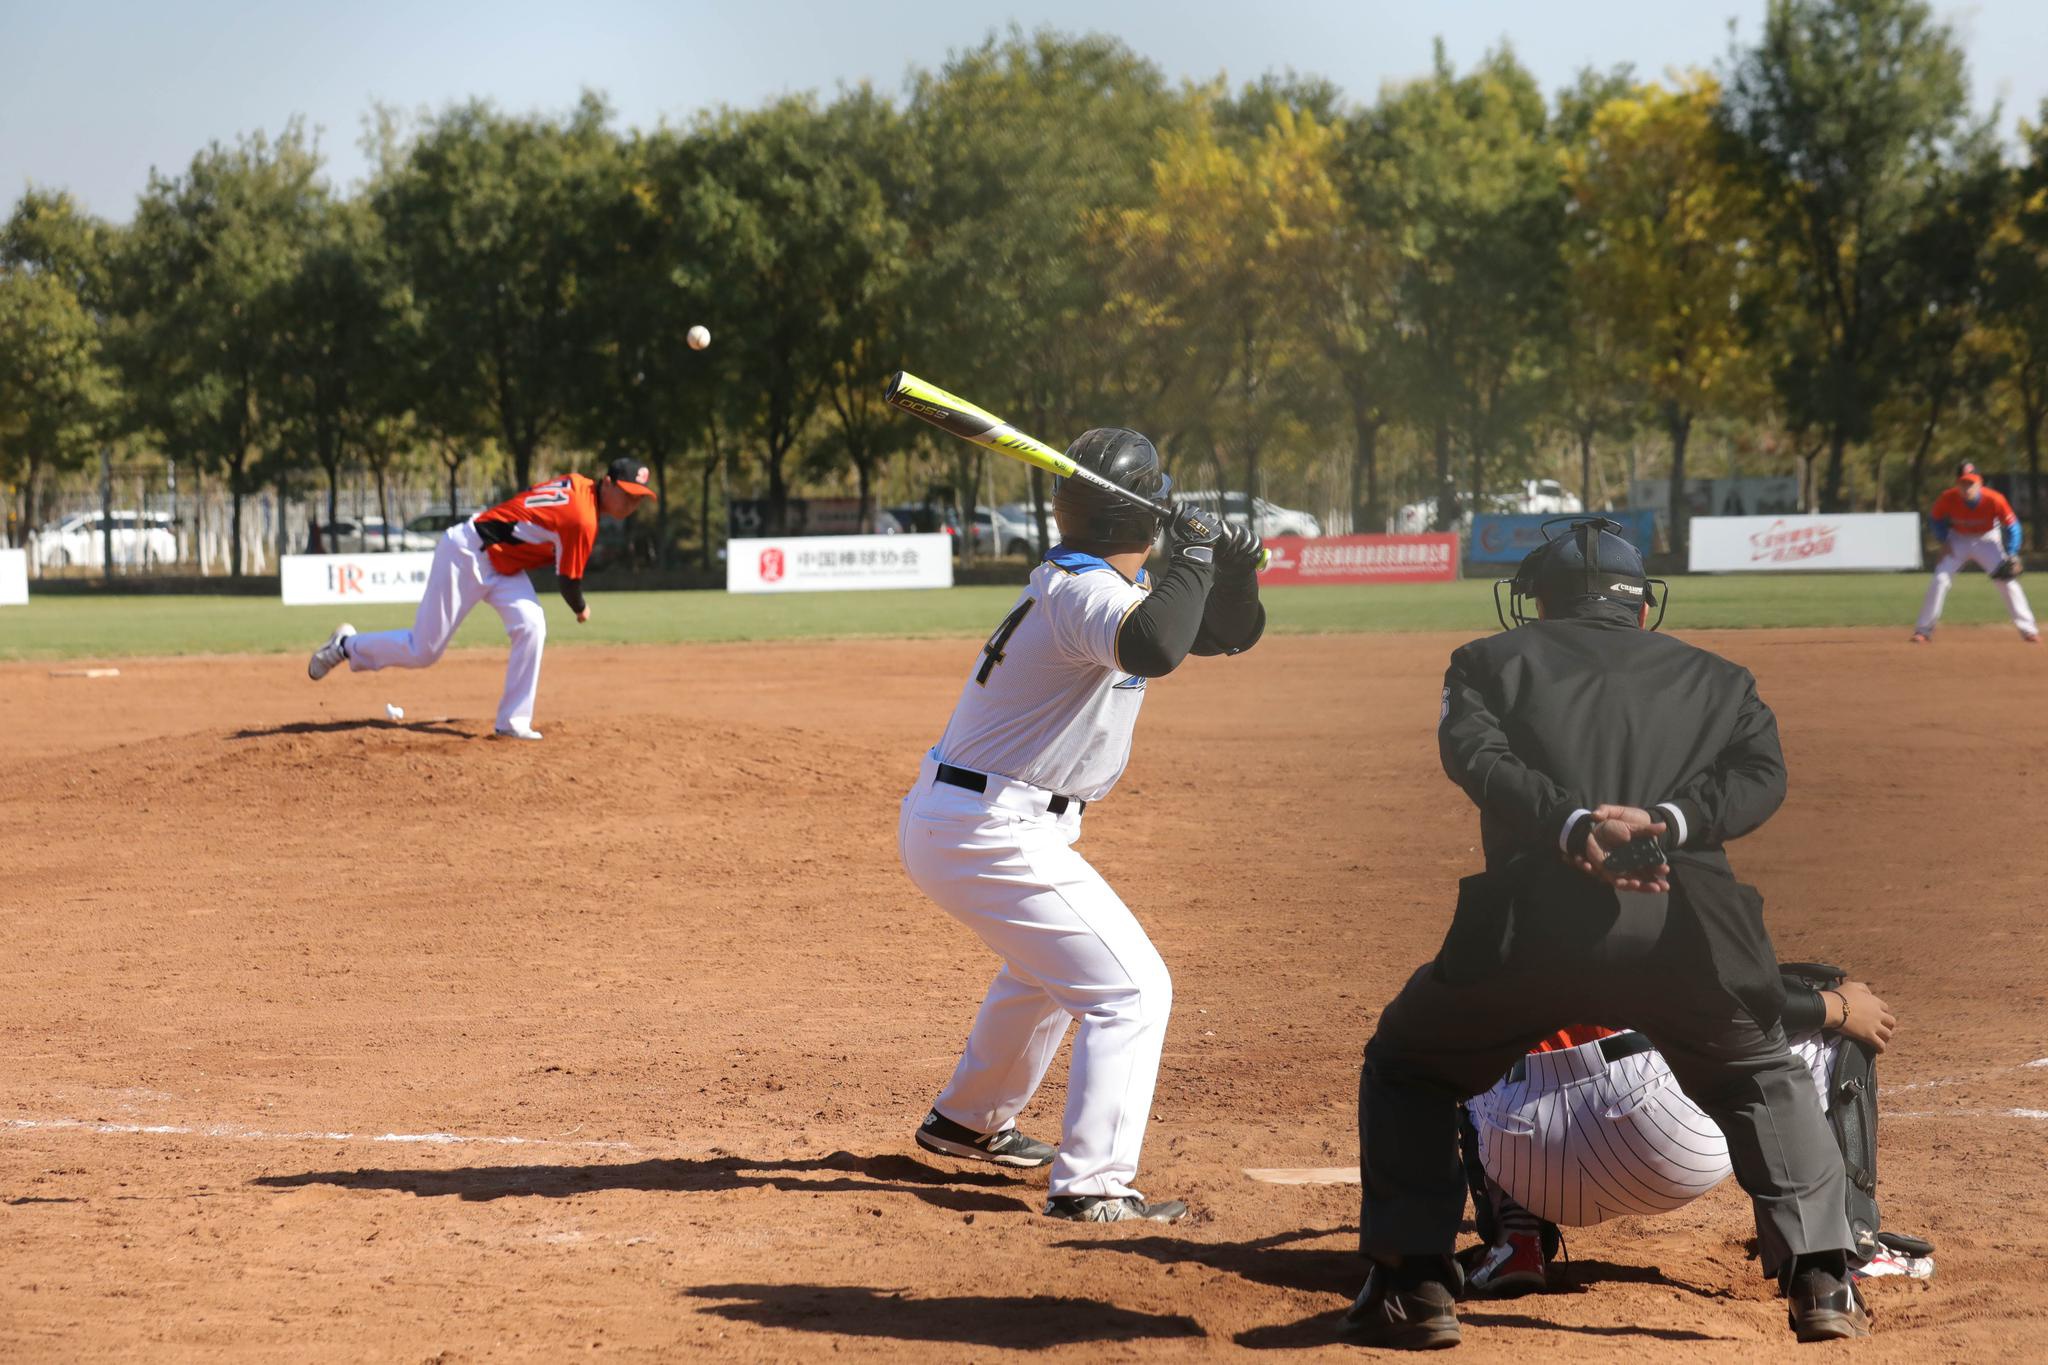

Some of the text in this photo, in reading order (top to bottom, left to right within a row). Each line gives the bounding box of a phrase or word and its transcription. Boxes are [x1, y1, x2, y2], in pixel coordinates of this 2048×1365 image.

[797, 548, 919, 568] 中国棒球协会
[975, 596, 1036, 688] 4
